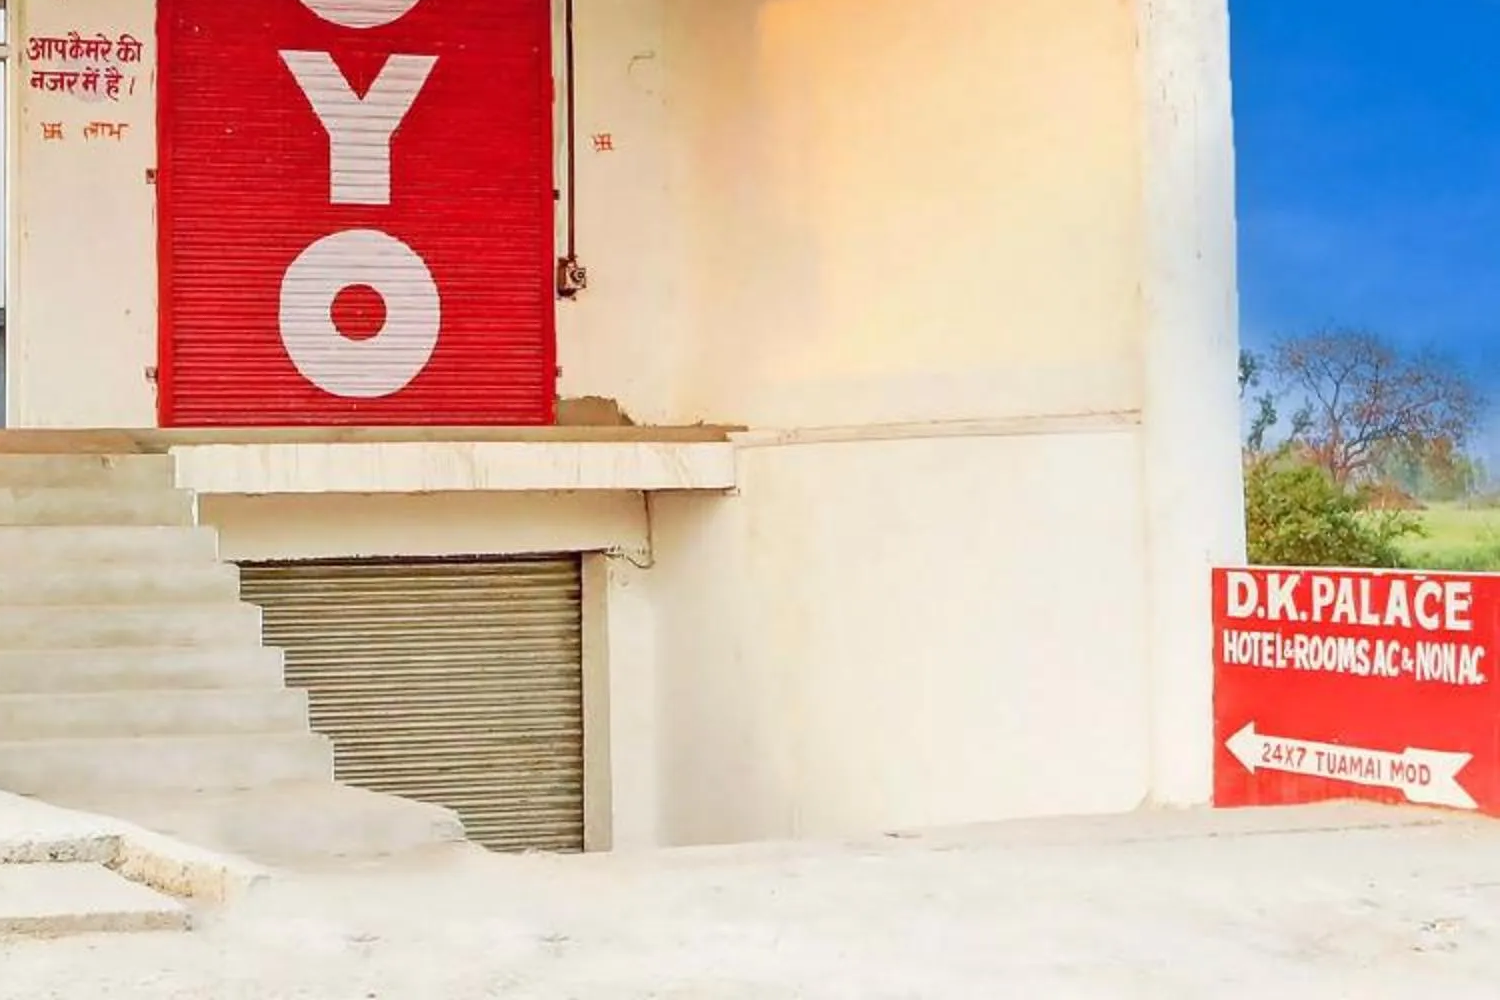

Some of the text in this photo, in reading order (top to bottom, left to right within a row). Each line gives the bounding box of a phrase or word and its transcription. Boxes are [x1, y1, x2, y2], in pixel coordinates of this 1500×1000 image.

[1261, 742, 1431, 786] 24X7 TUAMAI MOD
